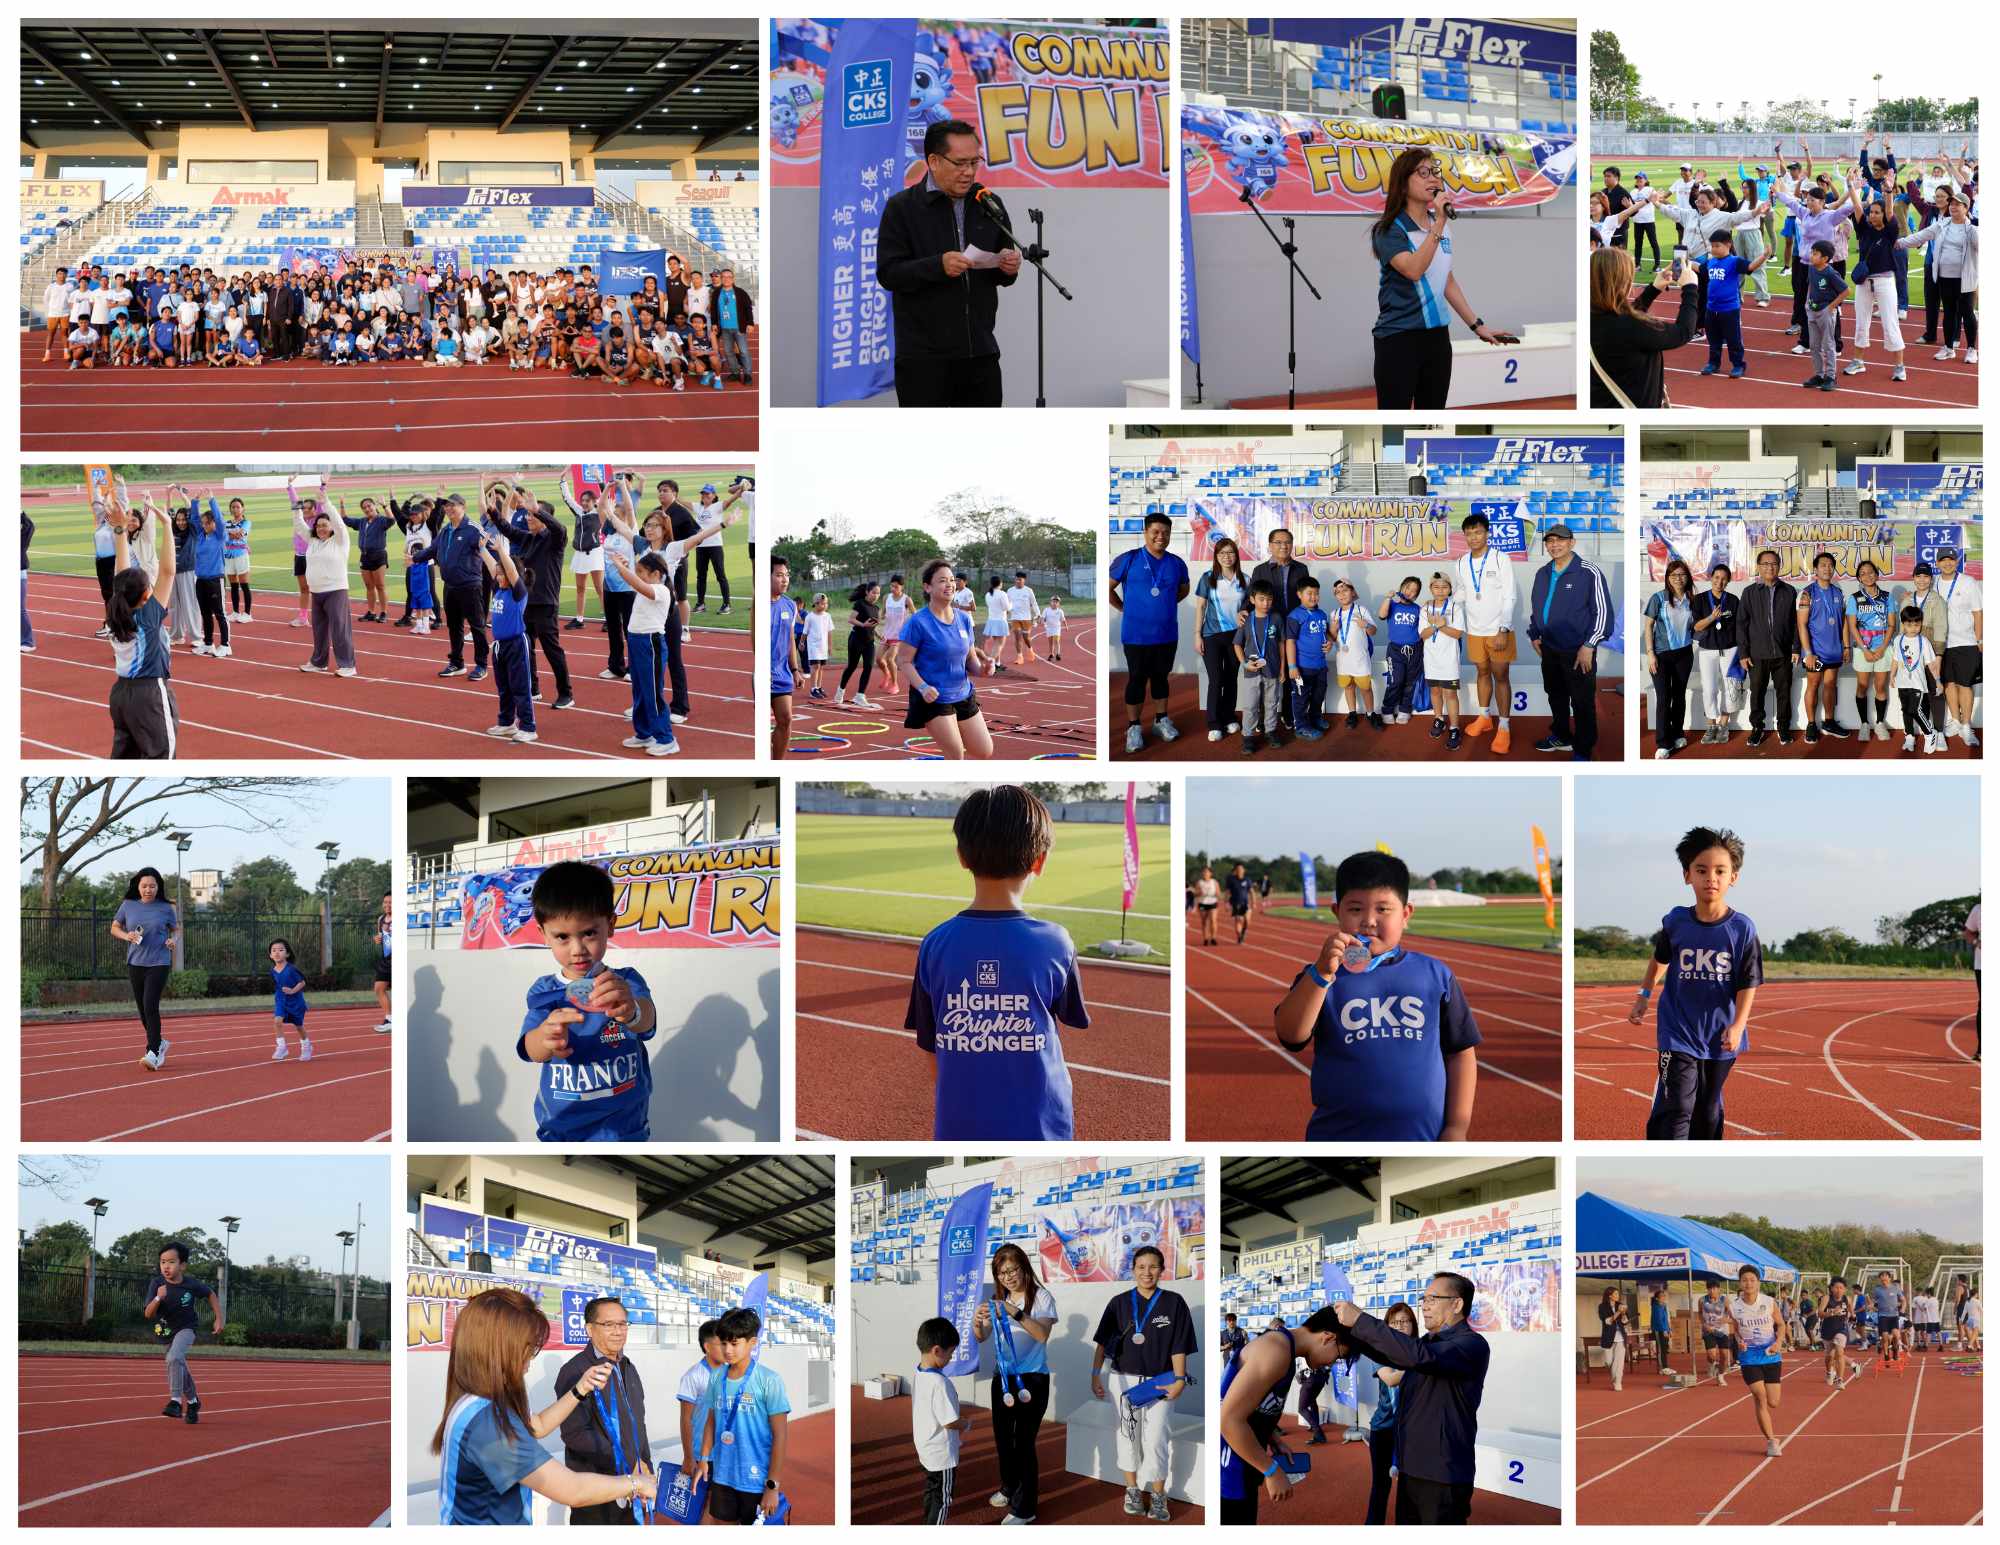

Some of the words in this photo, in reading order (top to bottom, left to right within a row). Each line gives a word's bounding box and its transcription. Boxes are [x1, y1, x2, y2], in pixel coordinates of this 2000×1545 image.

[854, 68, 884, 89] 中正
[848, 91, 887, 112] CKS
[849, 110, 886, 121] COLLEGE
[908, 128, 925, 137] 168
[978, 85, 1140, 172] FUN
[1323, 119, 1479, 150] COMMUNITY
[20, 184, 92, 198] FLEX
[1708, 267, 1726, 277] CKS
[859, 227, 879, 365] BRIGHTER
[832, 264, 854, 369] HIGHER
[872, 279, 890, 364] STRO
[1504, 359, 1518, 383] 2
[1313, 500, 1430, 519] COMMUNITY
[1481, 505, 1512, 521] 中正
[1294, 522, 1363, 557] FUN
[1373, 522, 1448, 557] RUN
[1489, 524, 1520, 538] KS
[1766, 523, 1878, 543] COMMUNITY
[1925, 528, 1953, 544] 中正
[1488, 537, 1520, 546] OLLEGE
[1394, 612, 1416, 622] CKS
[1513, 691, 1528, 711] 3
[614, 877, 696, 932] UN
[1680, 948, 1733, 975] CKS
[980, 973, 996, 981] CKS
[1679, 971, 1731, 982] COLLEGE
[947, 985, 1029, 1011] HIGHER
[1340, 995, 1425, 1030] CKS
[943, 1008, 1035, 1040] Brighter
[599, 1032, 626, 1041] SOCCER
[936, 1033, 1046, 1052] STRONGER
[1344, 1028, 1424, 1044] COLLEGE
[550, 1052, 638, 1091] FRANCE
[1416, 1207, 1510, 1243] Armak
[951, 1240, 973, 1250] CKS
[1243, 1243, 1315, 1268] PHILFLEX
[1508, 1460, 1524, 1484] 2
[670, 1495, 686, 1508] CKS
